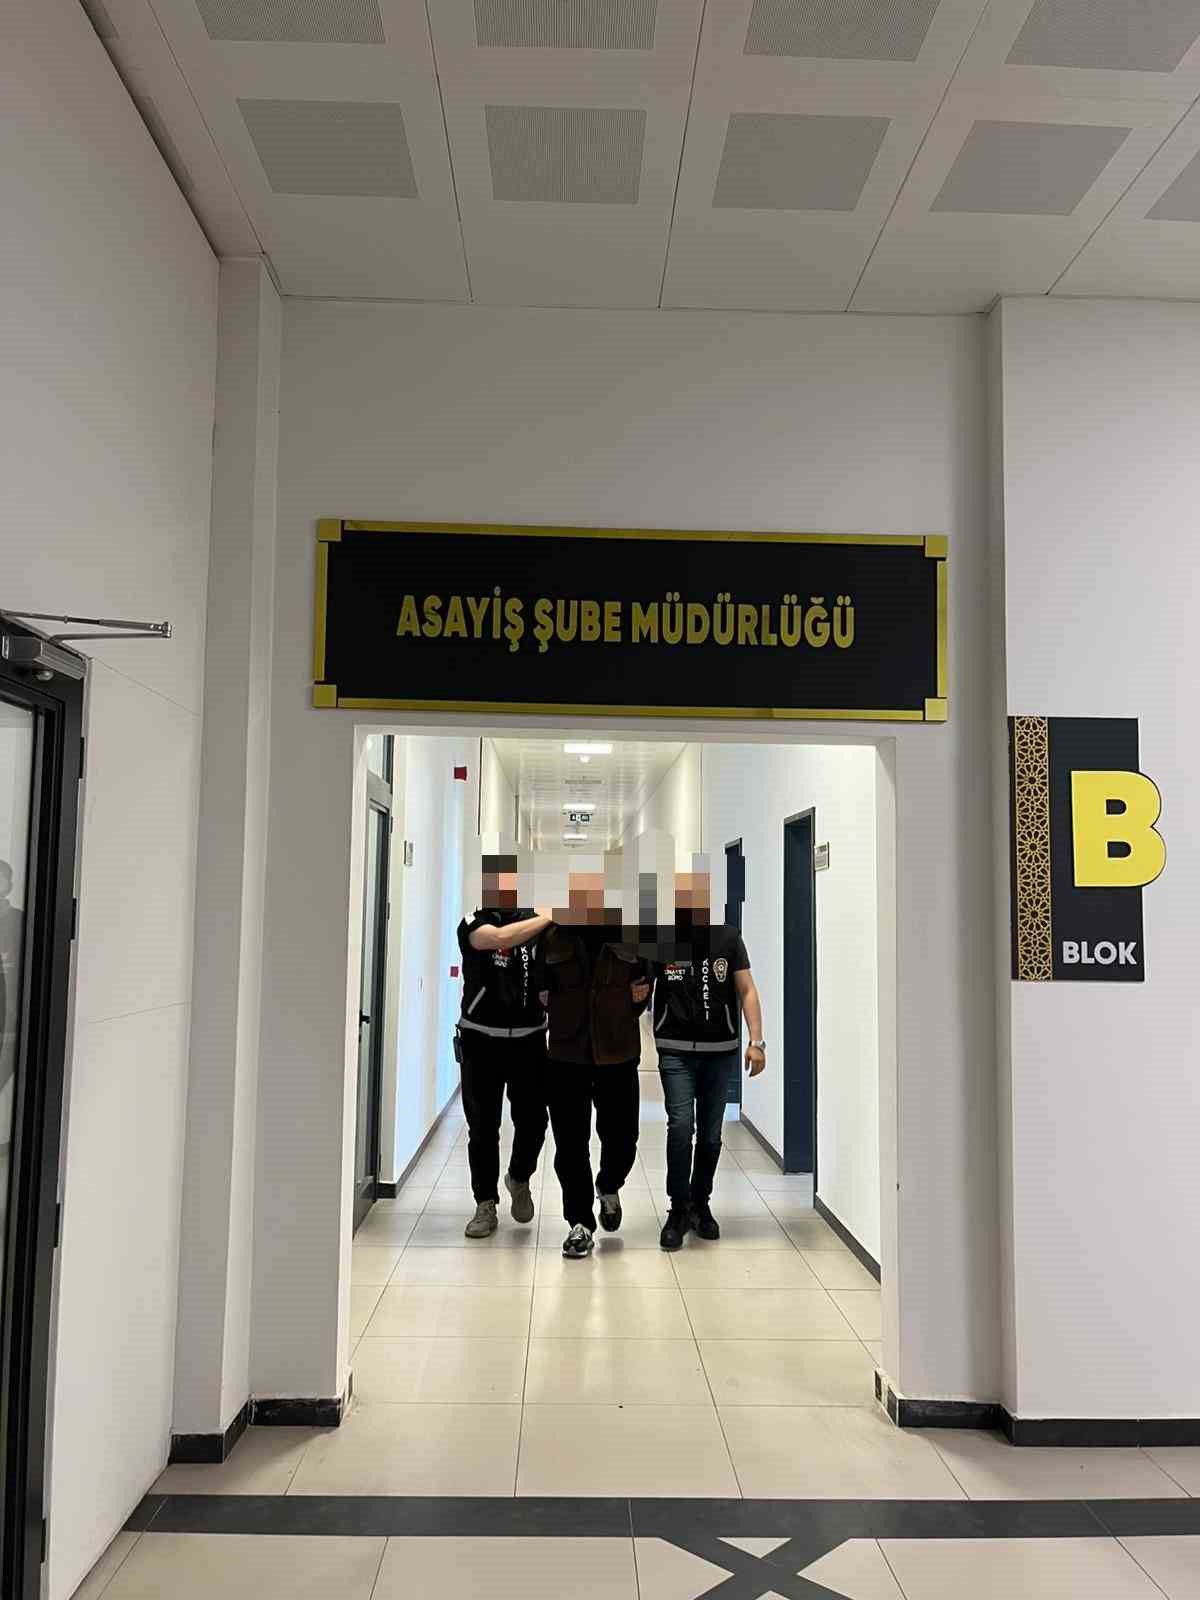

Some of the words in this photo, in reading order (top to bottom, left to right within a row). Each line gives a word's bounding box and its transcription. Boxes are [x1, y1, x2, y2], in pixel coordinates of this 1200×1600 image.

[396, 586, 524, 654] ASAYİŞ
[533, 598, 622, 655] ŞUBE
[631, 591, 855, 649] MÜDÜRLÜĞÜ
[1071, 770, 1166, 887] B
[1062, 940, 1137, 965] BLOK
